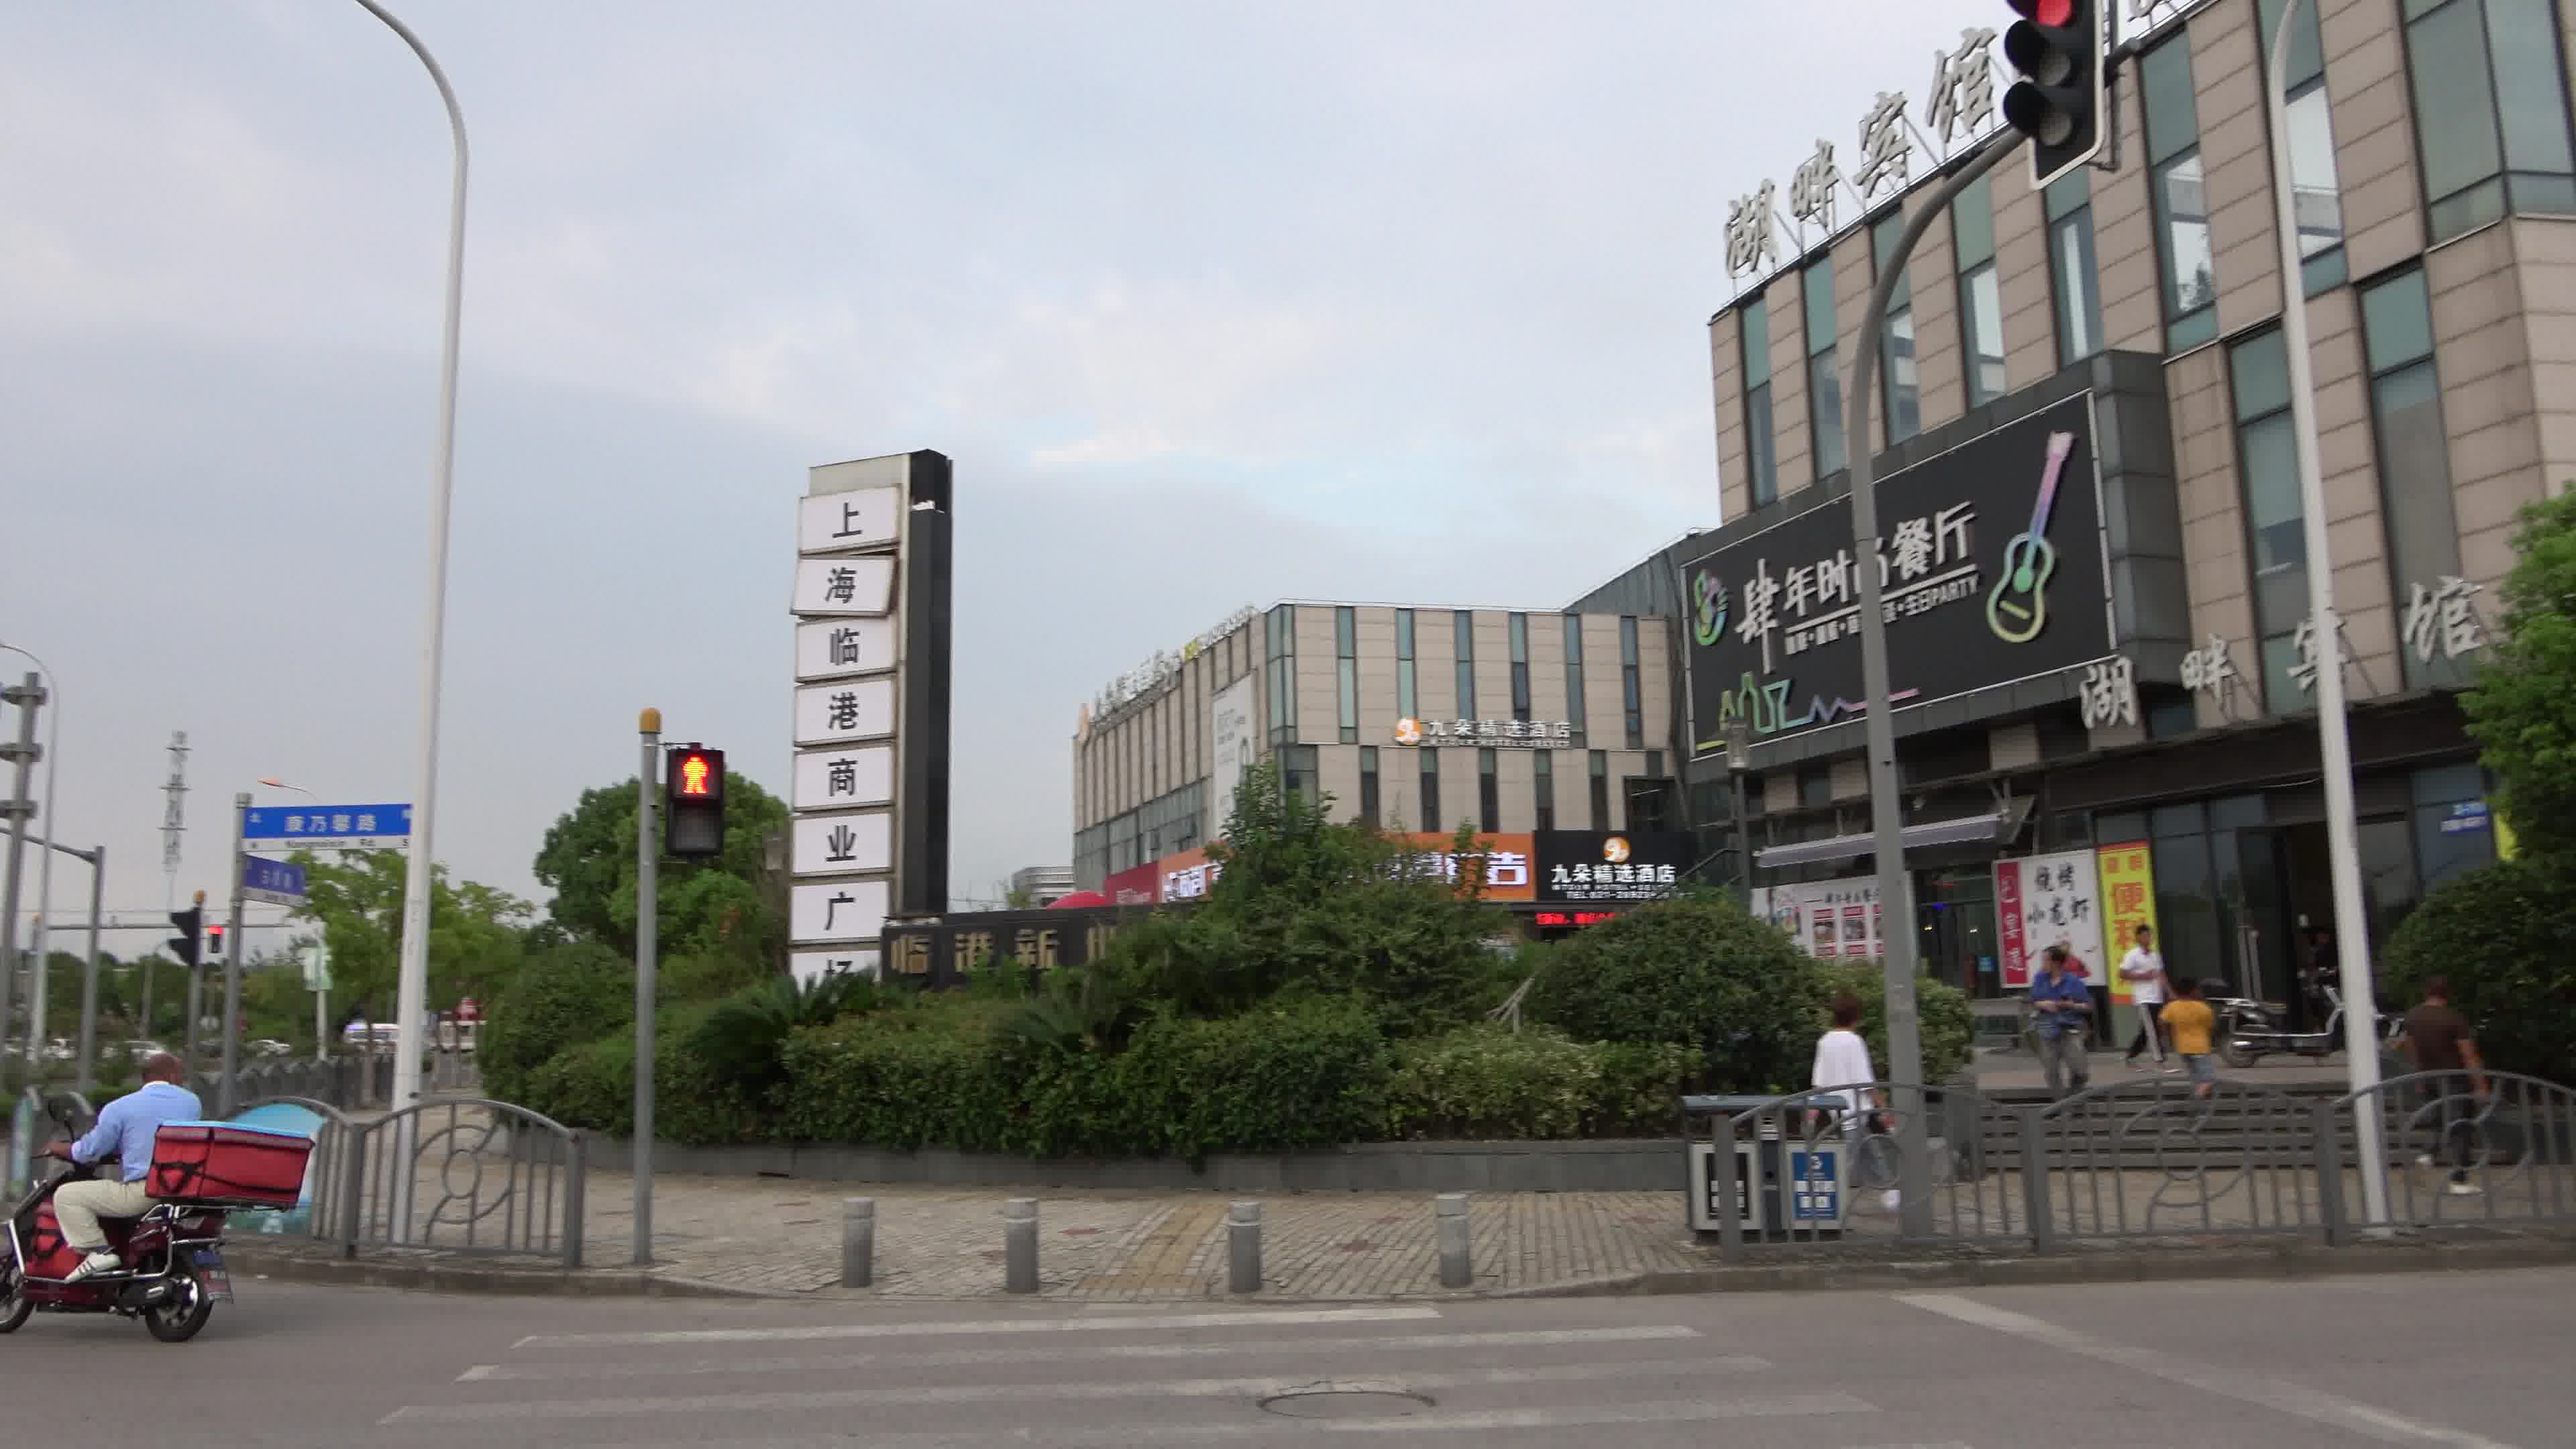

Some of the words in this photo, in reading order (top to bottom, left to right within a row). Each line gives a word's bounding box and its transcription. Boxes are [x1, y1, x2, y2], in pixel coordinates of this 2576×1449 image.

[1723, 27, 1997, 278] 湖畔宾馆
[1428, 719, 1570, 738] 九朵精选酒店
[284, 814, 376, 833] 康乃馨路
[1551, 864, 1675, 883] 九朵精选酒店
